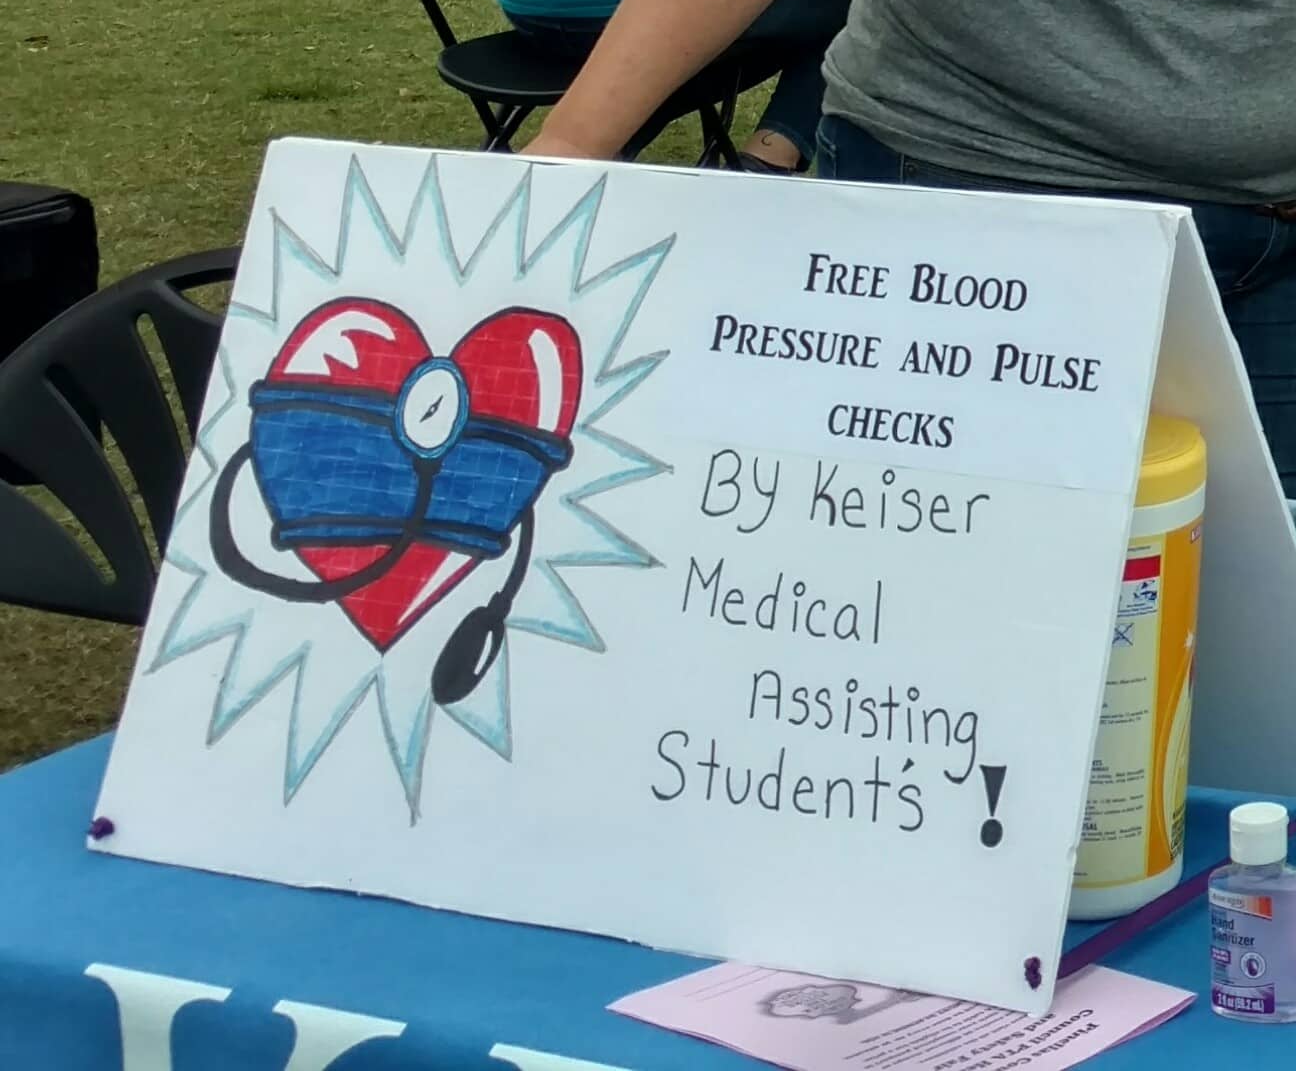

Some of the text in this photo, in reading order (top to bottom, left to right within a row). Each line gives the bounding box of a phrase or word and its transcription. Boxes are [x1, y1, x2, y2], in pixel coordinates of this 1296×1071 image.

[804, 253, 1028, 312] FREE BLOOD
[710, 315, 1101, 392] PRESSURE AND PULSE
[810, 460, 990, 533] Keiser
[683, 556, 882, 644] Medical
[750, 670, 978, 784] Assisting
[1211, 912, 1235, 931] Hand
[1212, 926, 1256, 947] Sanitizer
[970, 1030, 1026, 1056] Safety
[990, 1008, 1095, 1061] Council PTA
[1031, 1022, 1100, 1058] Pinellas
